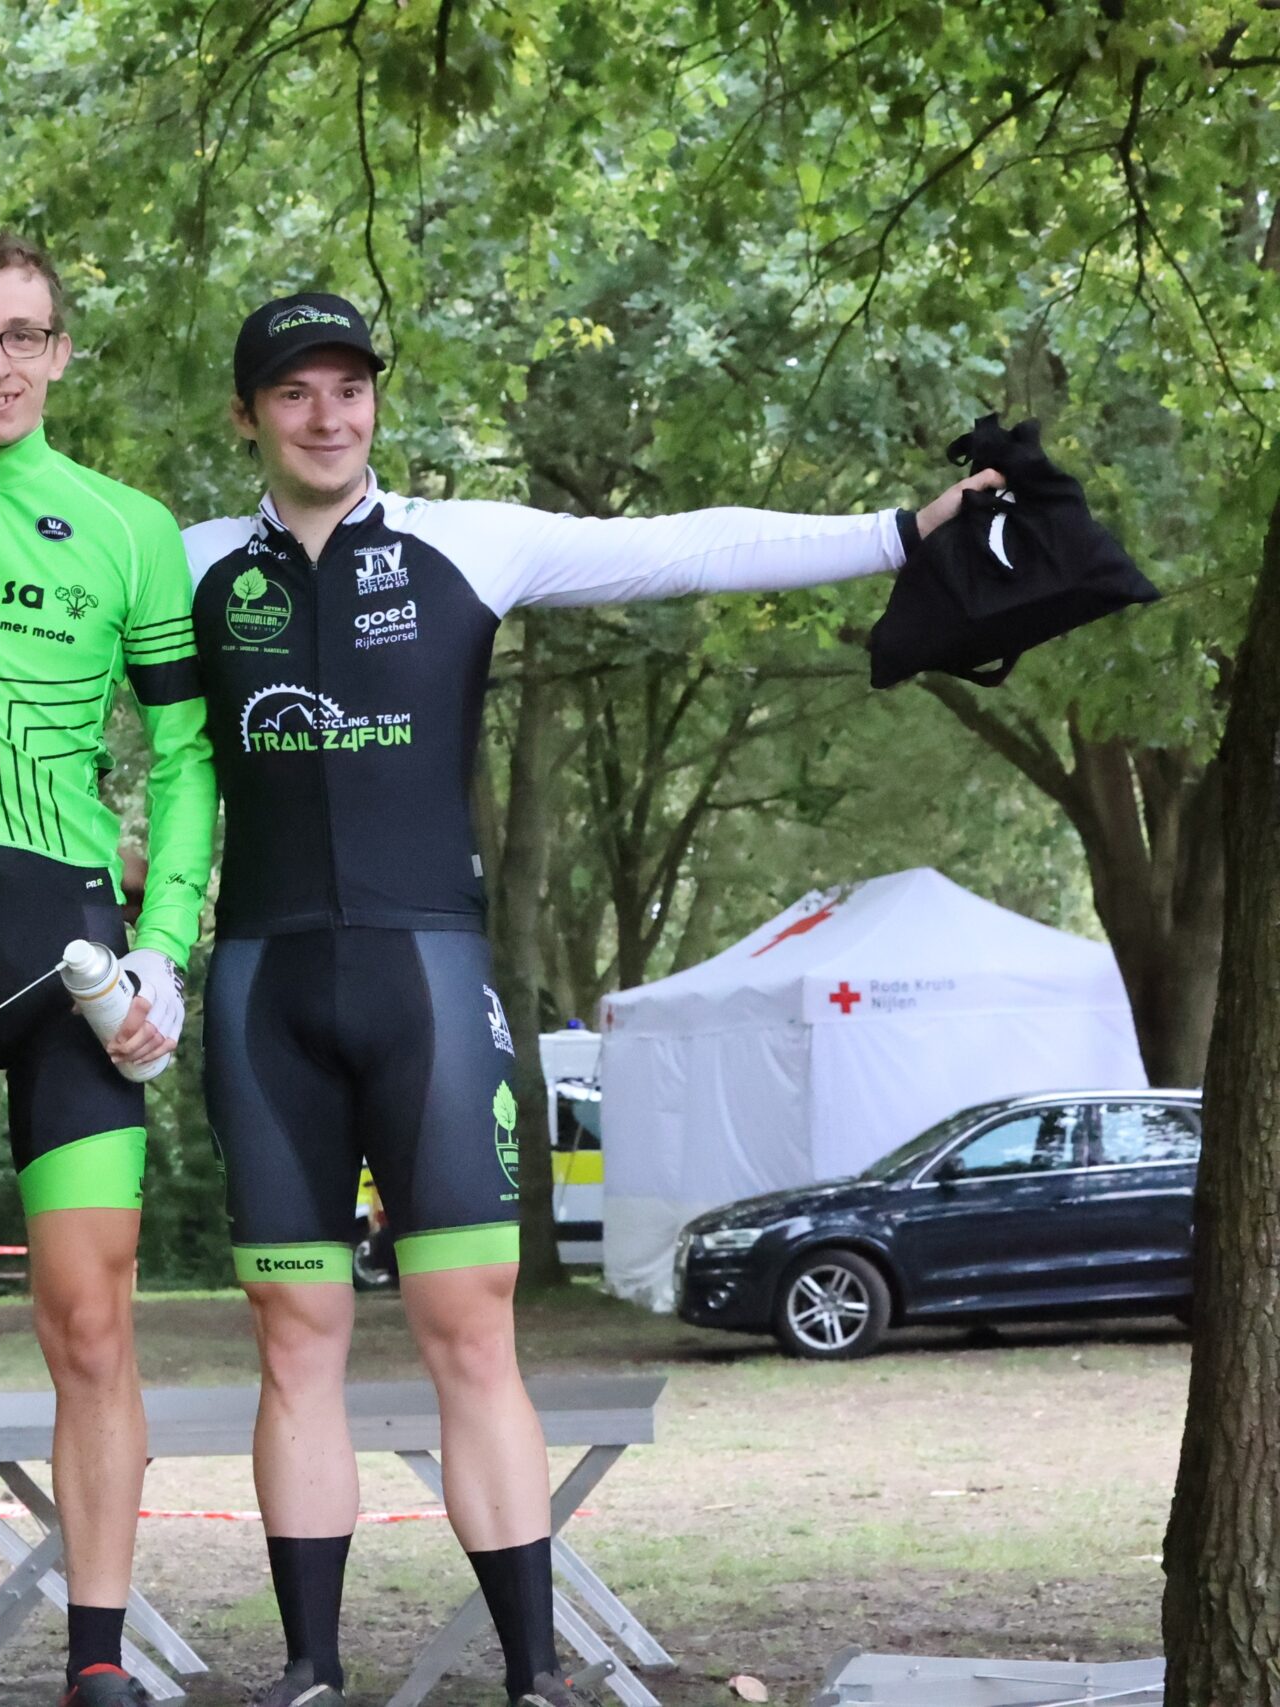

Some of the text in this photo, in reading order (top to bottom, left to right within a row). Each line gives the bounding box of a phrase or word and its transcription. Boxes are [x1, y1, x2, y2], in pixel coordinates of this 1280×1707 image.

[357, 571, 408, 589] REPAIR
[354, 600, 417, 633] goed
[32, 625, 75, 645] mode
[369, 620, 417, 636] apotheek
[355, 628, 417, 650] Rijkevorsel
[313, 713, 411, 729] CYCLING TEAM
[870, 977, 956, 993] Rode Kruis
[872, 997, 917, 1013] Nijlen
